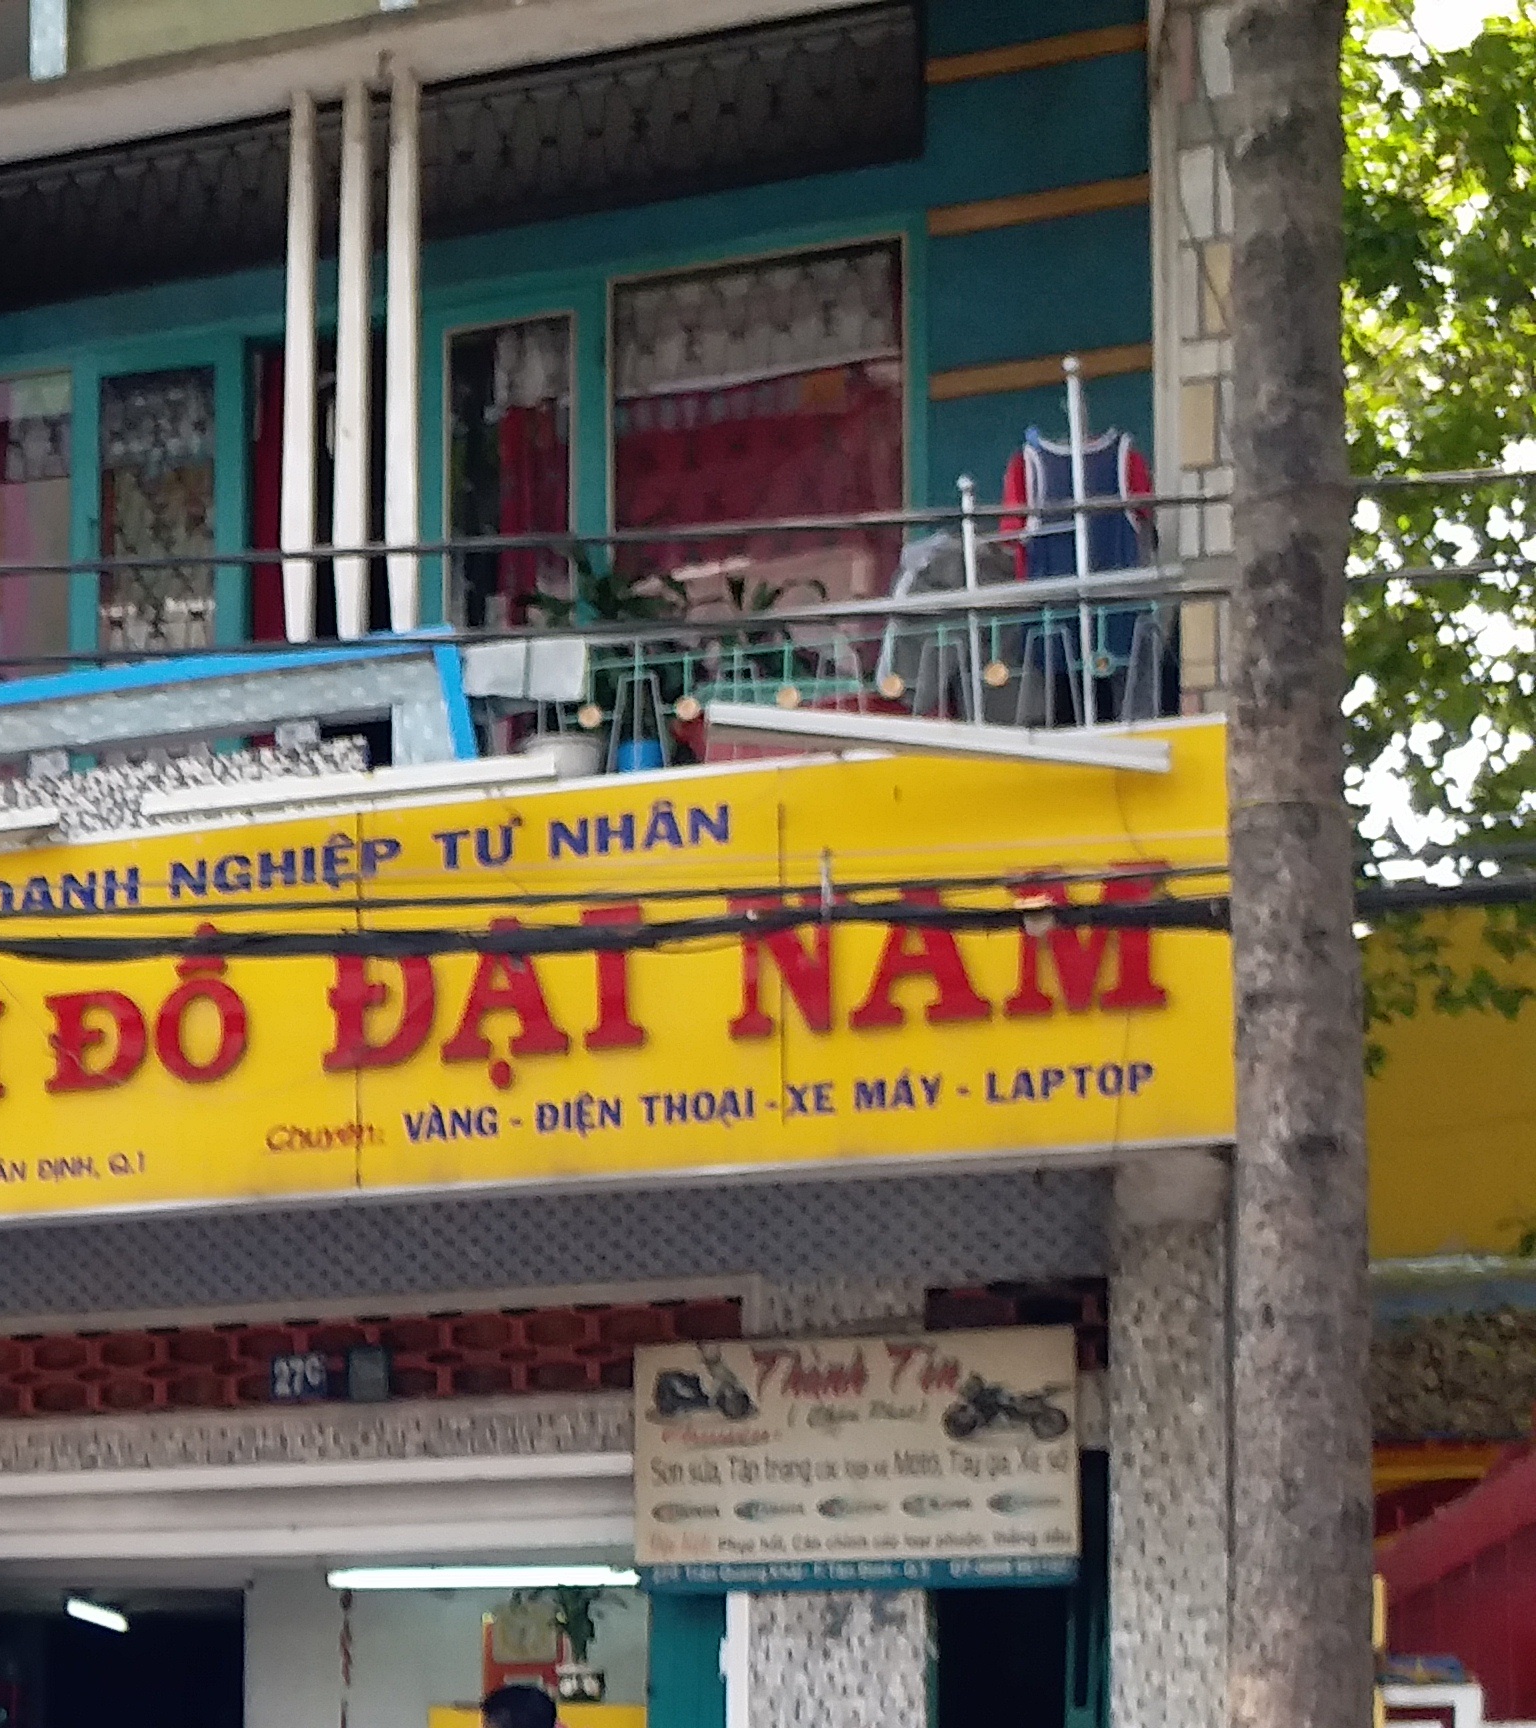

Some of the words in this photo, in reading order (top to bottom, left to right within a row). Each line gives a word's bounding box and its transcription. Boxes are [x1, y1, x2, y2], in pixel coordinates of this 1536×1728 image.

[168, 832, 402, 899] NGHIỆP
[548, 801, 731, 857] NHÂN
[45, 922, 249, 1093] ĐỒ
[323, 902, 648, 1090] ĐẠI
[727, 861, 1169, 1039] NAM
[402, 1102, 499, 1144] VÀNG
[535, 1091, 623, 1141] ĐIỆN
[639, 1086, 756, 1129] THOẠI
[787, 1083, 835, 1115] XE
[854, 1069, 943, 1113] MÁY
[985, 1062, 1156, 1103] LAPTOP
